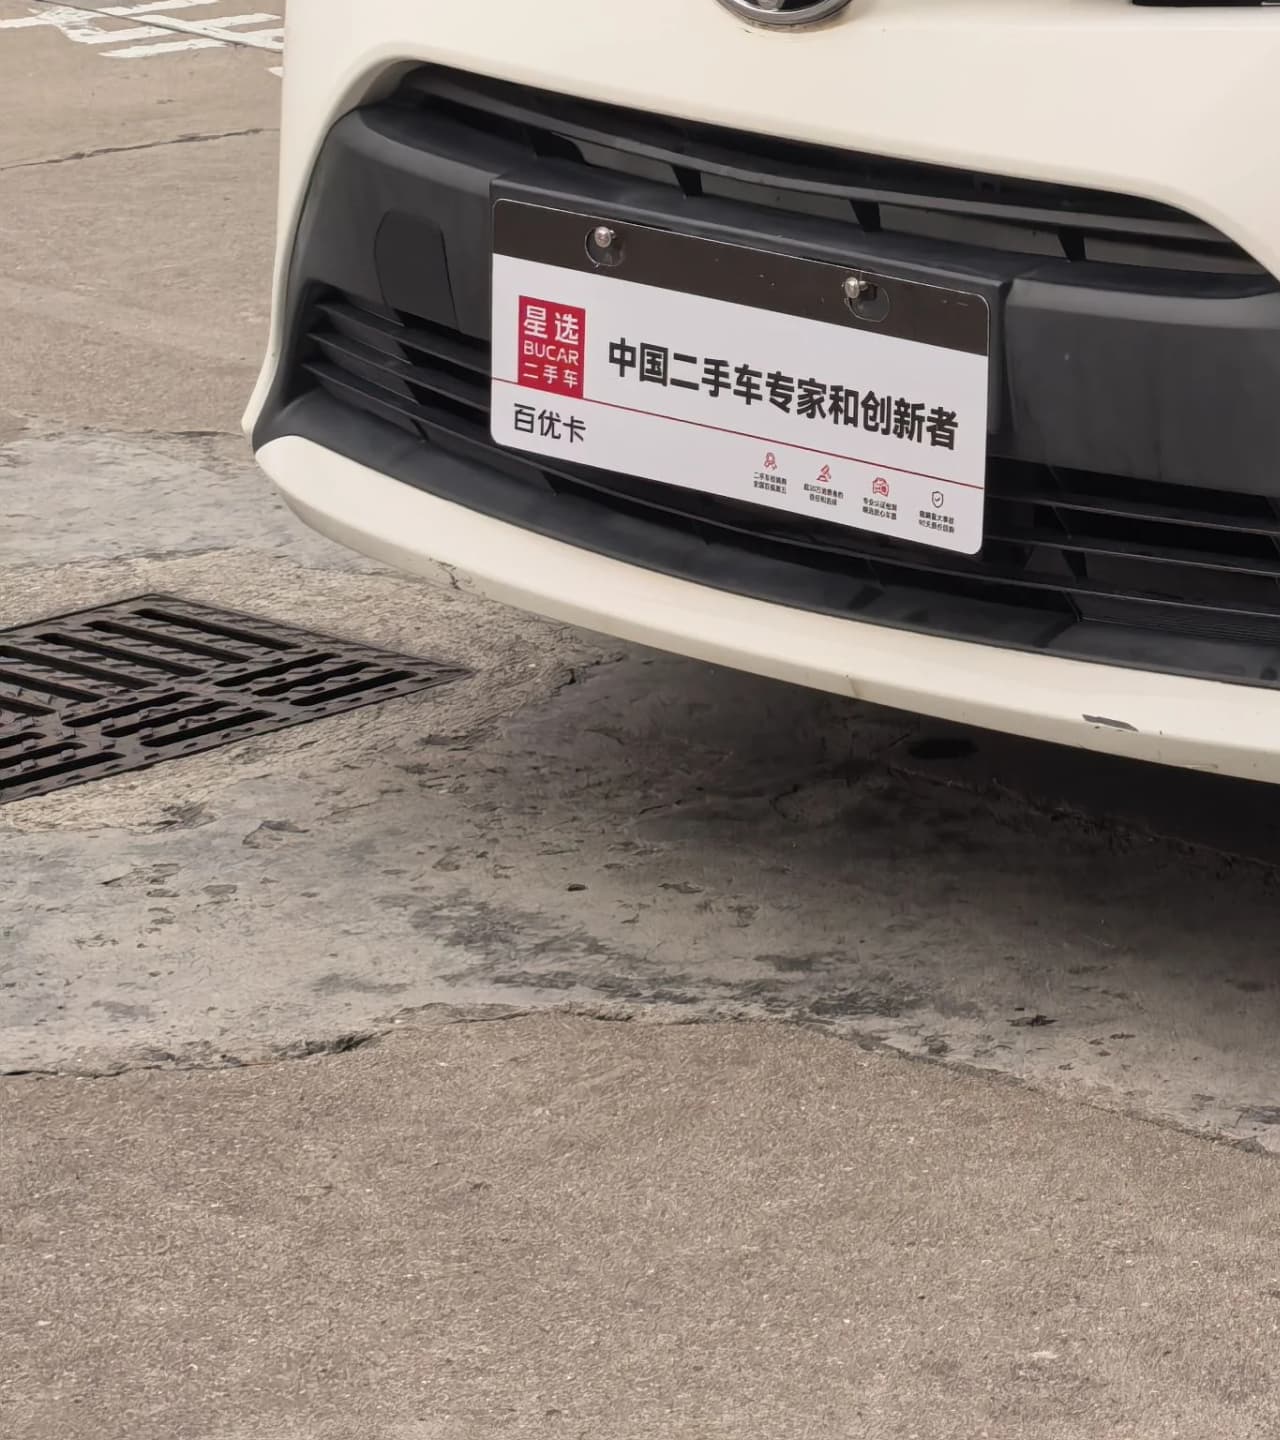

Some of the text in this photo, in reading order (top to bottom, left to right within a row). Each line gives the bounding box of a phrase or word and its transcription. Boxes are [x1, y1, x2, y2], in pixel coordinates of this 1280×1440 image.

[523, 304, 580, 346] 星选
[523, 340, 579, 366] BUCAR
[523, 361, 579, 389] 二手车
[607, 337, 960, 451] 中国二手车专家和创新者
[513, 402, 587, 444] 百优卡
